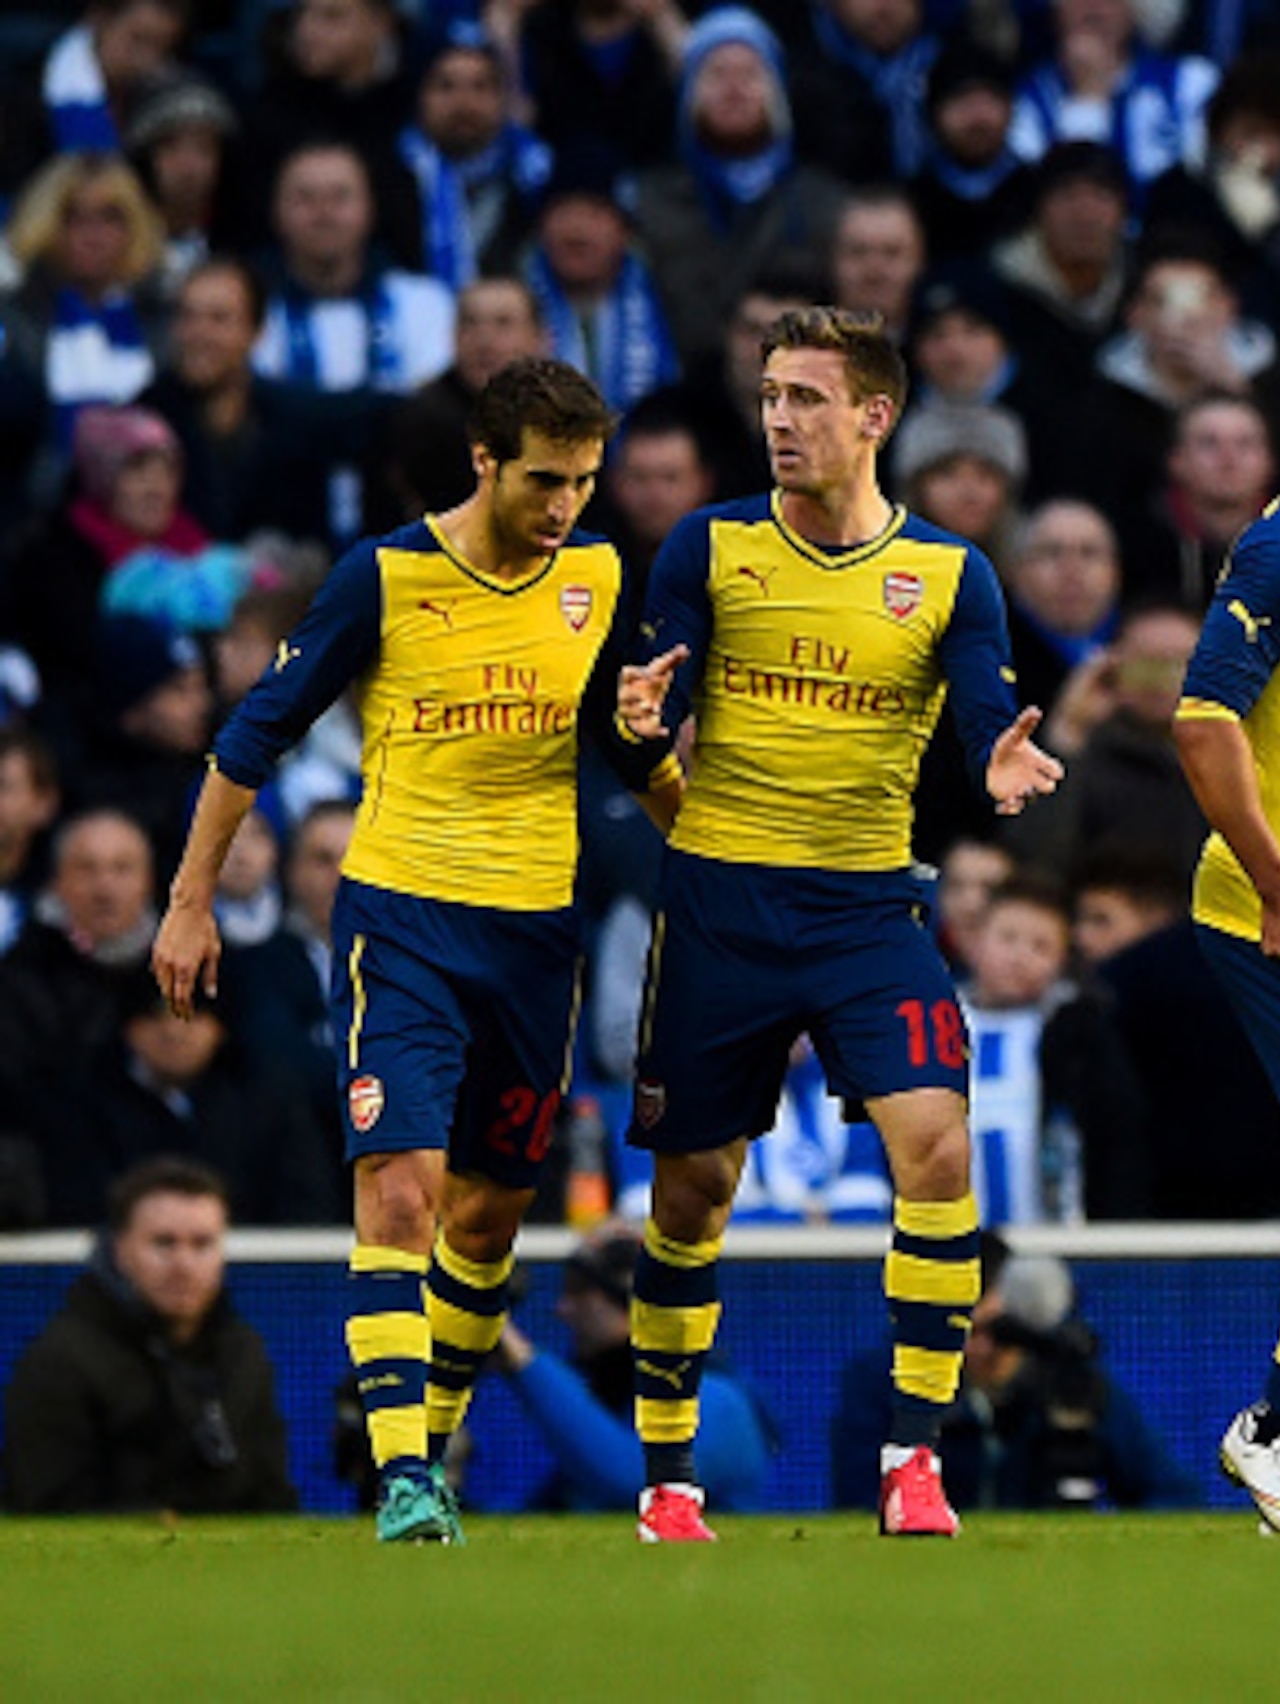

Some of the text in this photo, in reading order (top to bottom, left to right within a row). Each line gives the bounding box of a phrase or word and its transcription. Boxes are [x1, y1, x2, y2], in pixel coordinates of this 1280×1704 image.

[791, 636, 850, 675] Fly
[484, 664, 538, 699] Fly
[724, 656, 906, 714] Emirates
[894, 998, 964, 1070] 18
